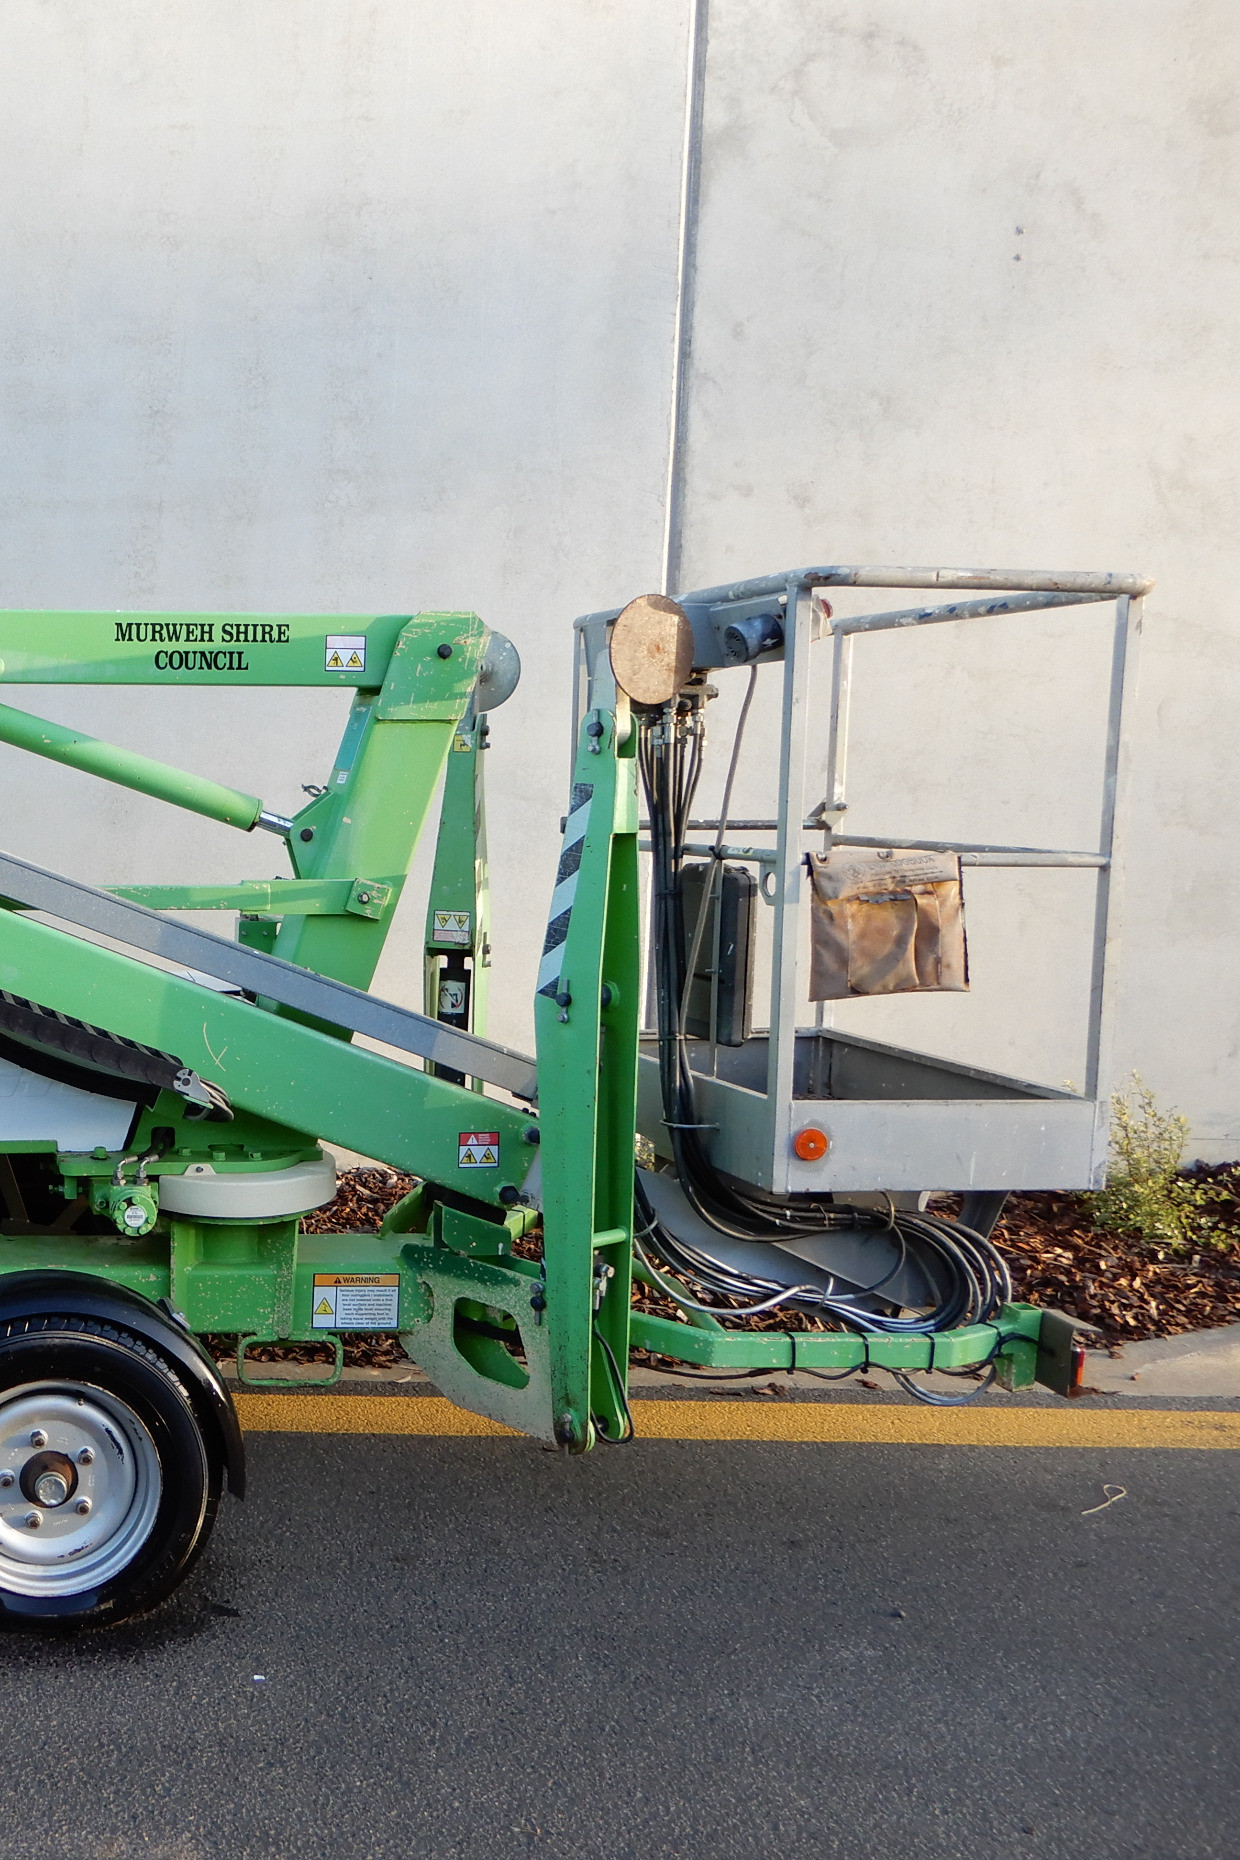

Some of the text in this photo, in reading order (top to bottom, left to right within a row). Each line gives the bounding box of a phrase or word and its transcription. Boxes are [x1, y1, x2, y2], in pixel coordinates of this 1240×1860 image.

[114, 622, 290, 643] MURWEH SHIRE
[154, 649, 249, 671] COUNCIL
